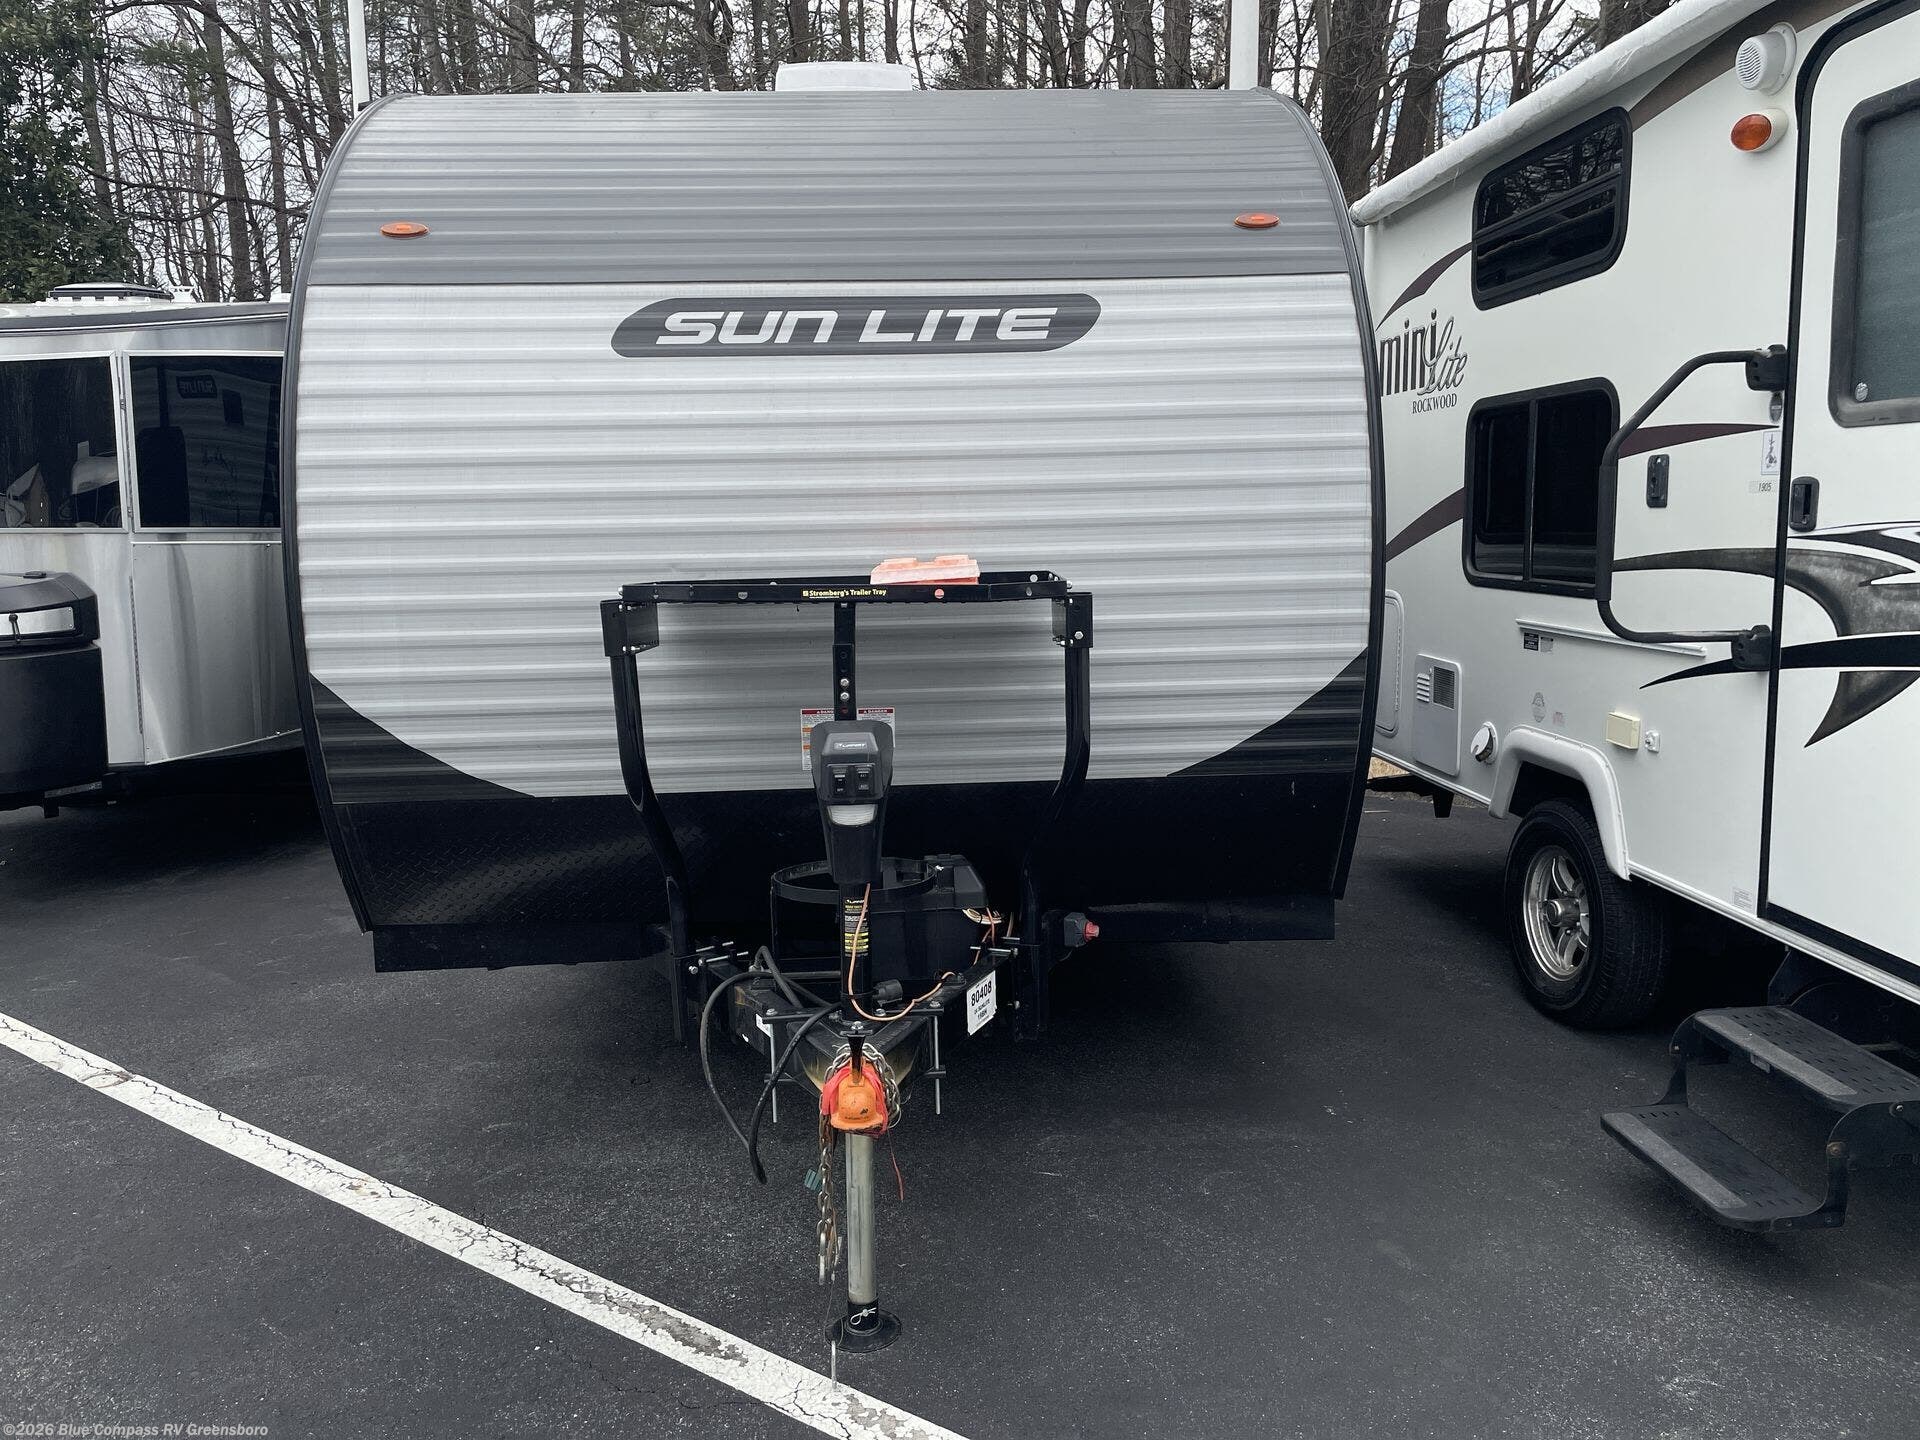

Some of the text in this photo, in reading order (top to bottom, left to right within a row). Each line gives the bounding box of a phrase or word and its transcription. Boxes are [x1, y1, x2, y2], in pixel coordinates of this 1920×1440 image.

[656, 307, 1058, 344] SUN LITE
[1380, 308, 1468, 396] mini Lite
[1412, 393, 1458, 414] ROCKWOOD
[809, 589, 849, 597] Stromberg's
[872, 588, 887, 596] Tray
[971, 981, 992, 1007] 80408
